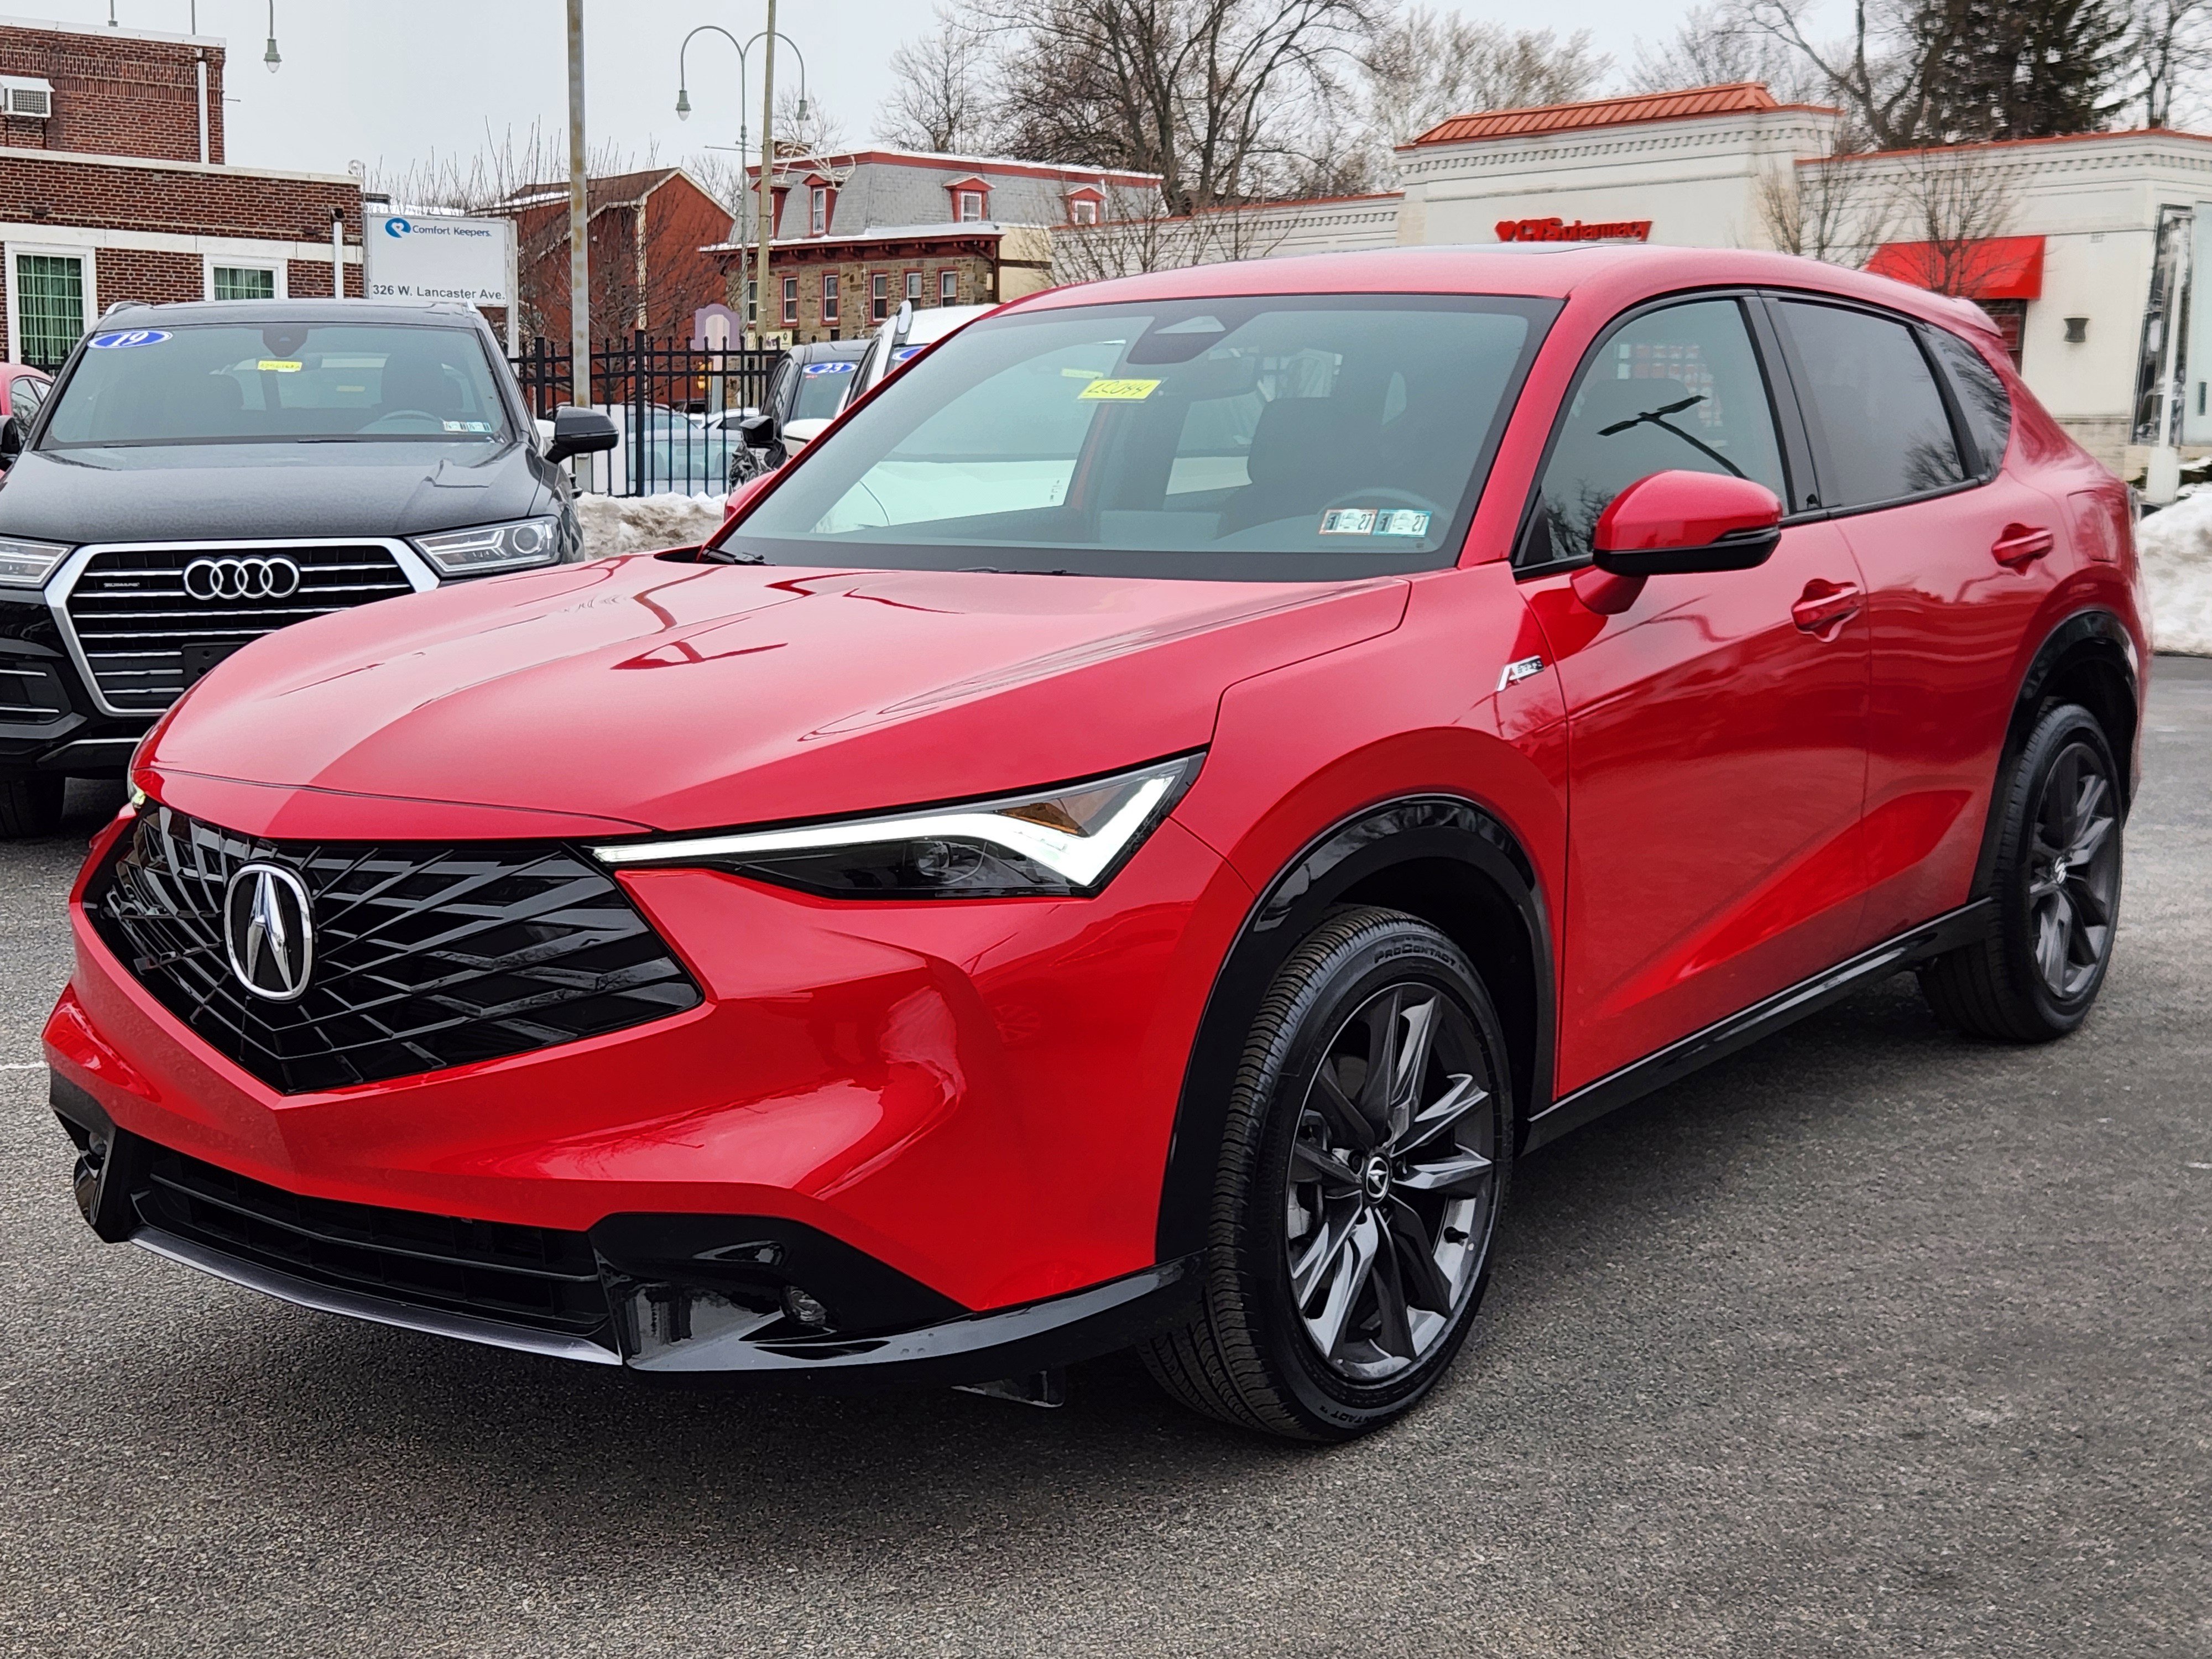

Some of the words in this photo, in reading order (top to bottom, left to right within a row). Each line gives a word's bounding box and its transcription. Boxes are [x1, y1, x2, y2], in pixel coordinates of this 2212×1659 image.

[413, 225, 450, 235] Comfort
[373, 285, 394, 295] 326
[398, 285, 413, 296] W.
[417, 286, 476, 299] Lancaster
[479, 289, 505, 300] Ave.
[108, 331, 149, 346] 19
[817, 362, 844, 373] 23
[1358, 513, 1373, 531] 27
[1411, 515, 1426, 532] 27
